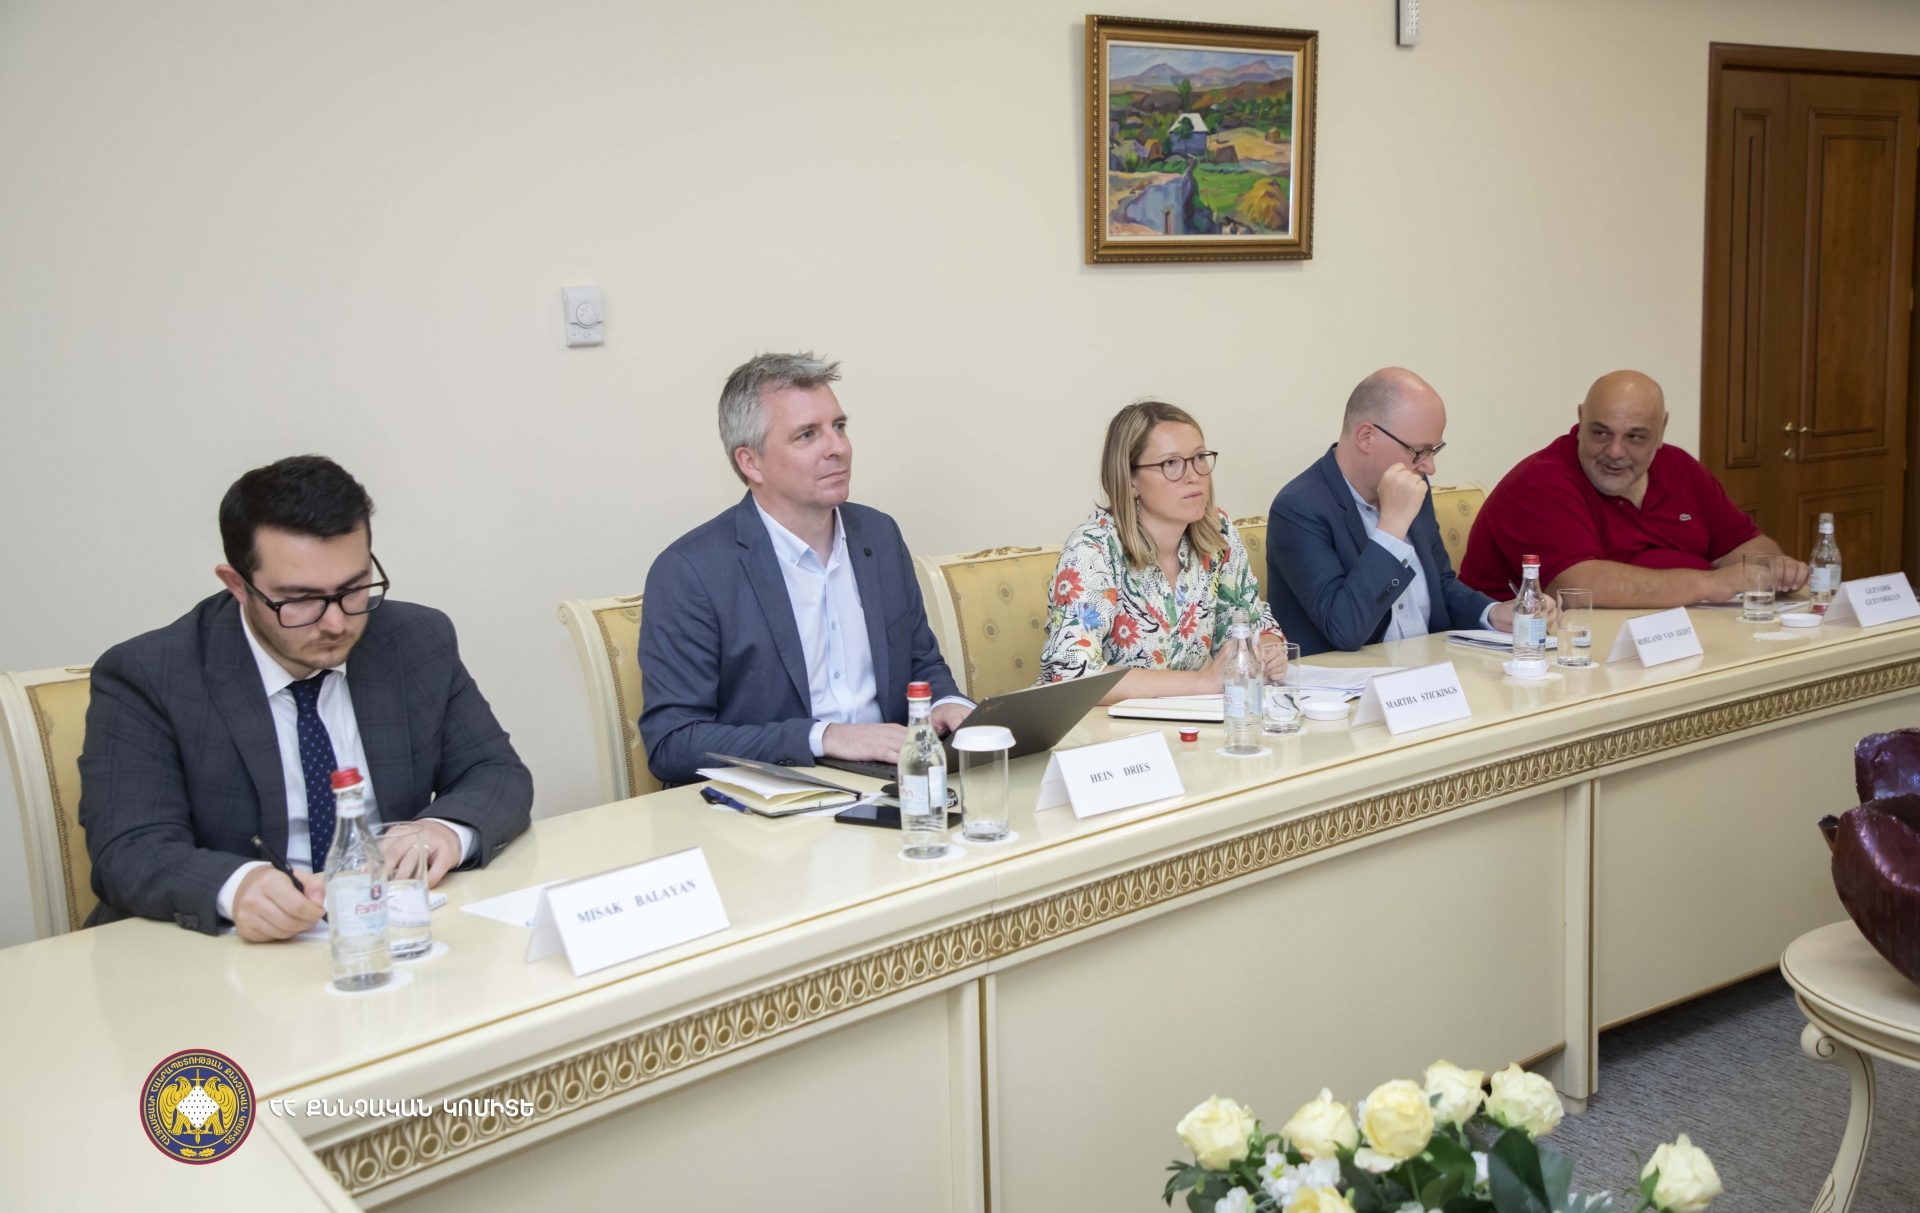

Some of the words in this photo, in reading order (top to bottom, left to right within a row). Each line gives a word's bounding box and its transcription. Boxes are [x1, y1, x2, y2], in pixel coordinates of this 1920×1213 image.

[1637, 633, 1663, 646] ROELAND
[1663, 631, 1675, 639] VAN
[1385, 696, 1418, 709] MARTHA
[1420, 686, 1458, 702] STICKINGS
[1089, 770, 1114, 784] HEIN
[1123, 762, 1151, 776] DRIES
[577, 901, 623, 924] MISAK
[634, 879, 697, 907] BALAYAN
